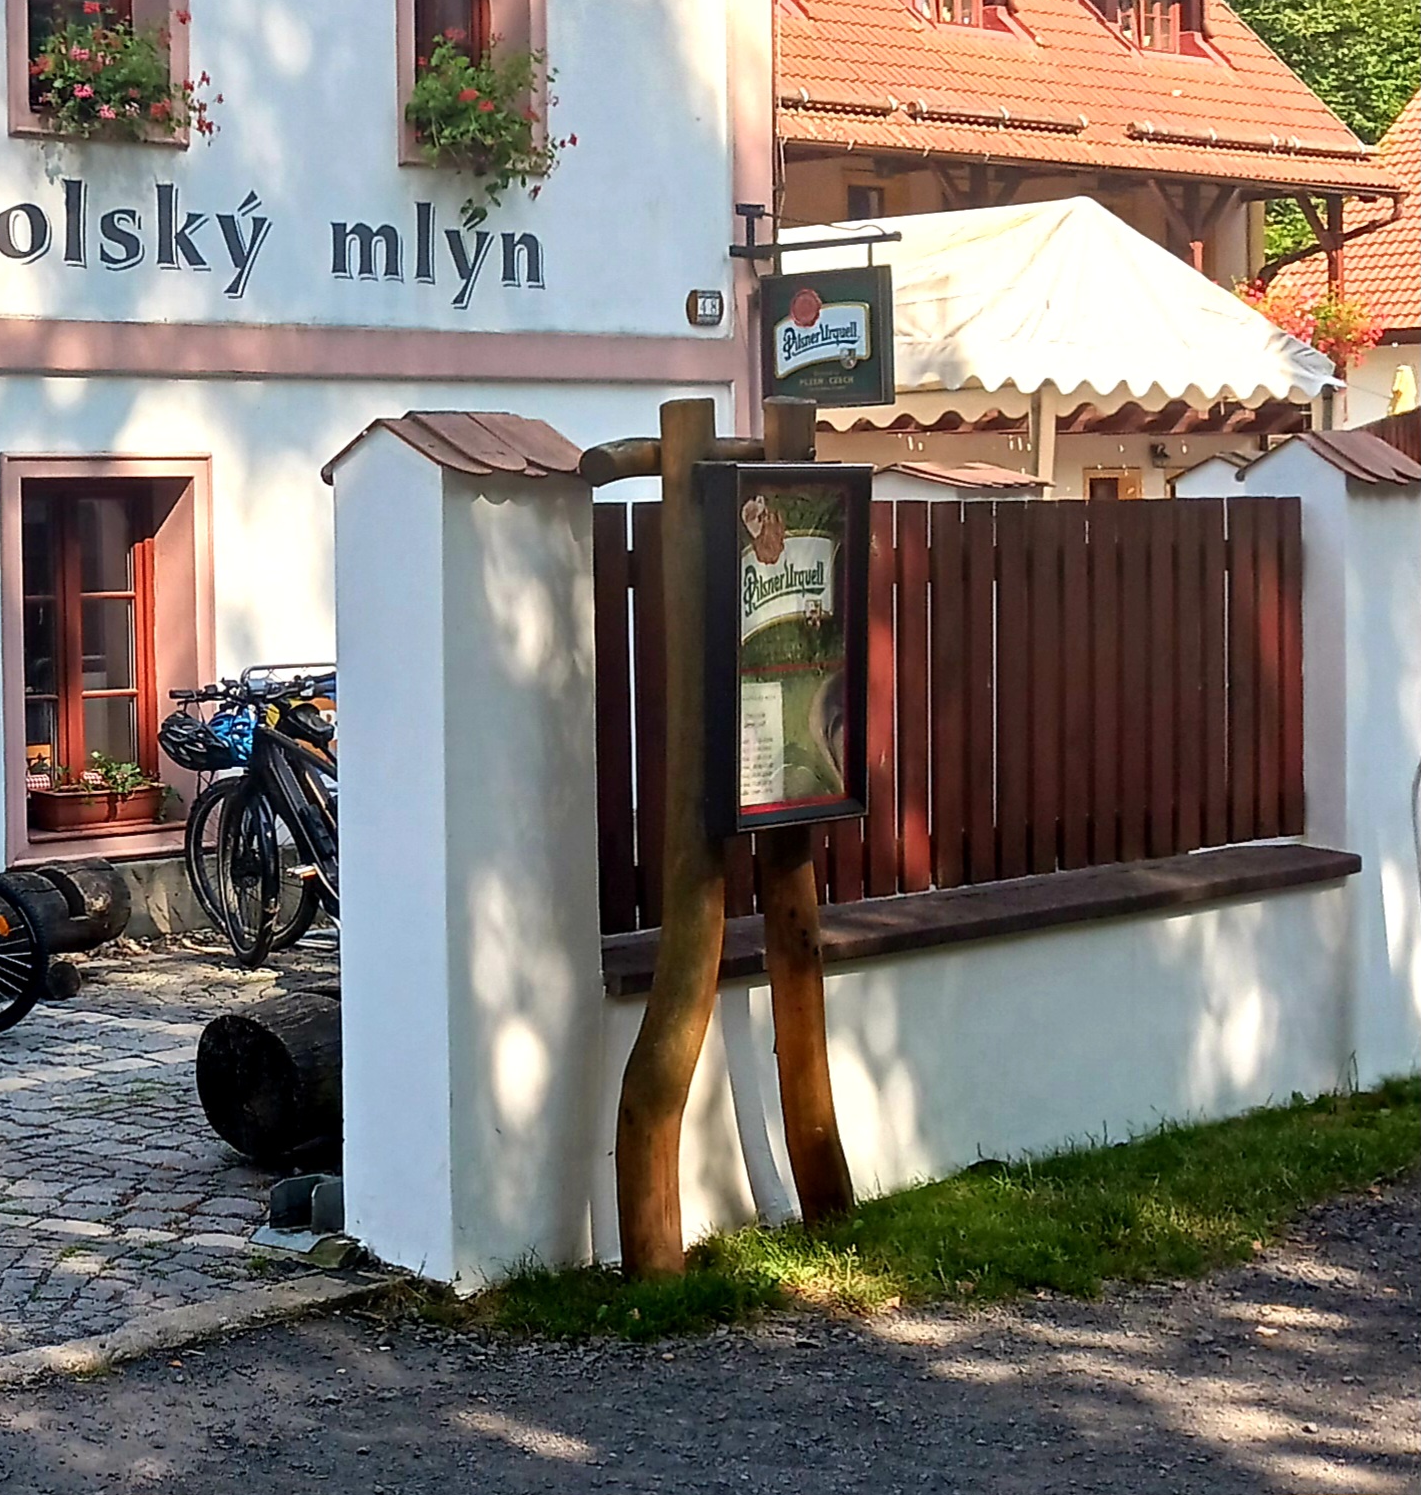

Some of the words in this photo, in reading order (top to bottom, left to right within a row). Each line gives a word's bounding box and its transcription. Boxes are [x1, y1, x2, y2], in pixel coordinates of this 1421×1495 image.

[330, 201, 547, 310] mlýn
[783, 328, 821, 360] Pilsner
[819, 321, 858, 345] Urquell
[743, 565, 786, 617] Pilsner
[784, 558, 824, 597] Urquell
